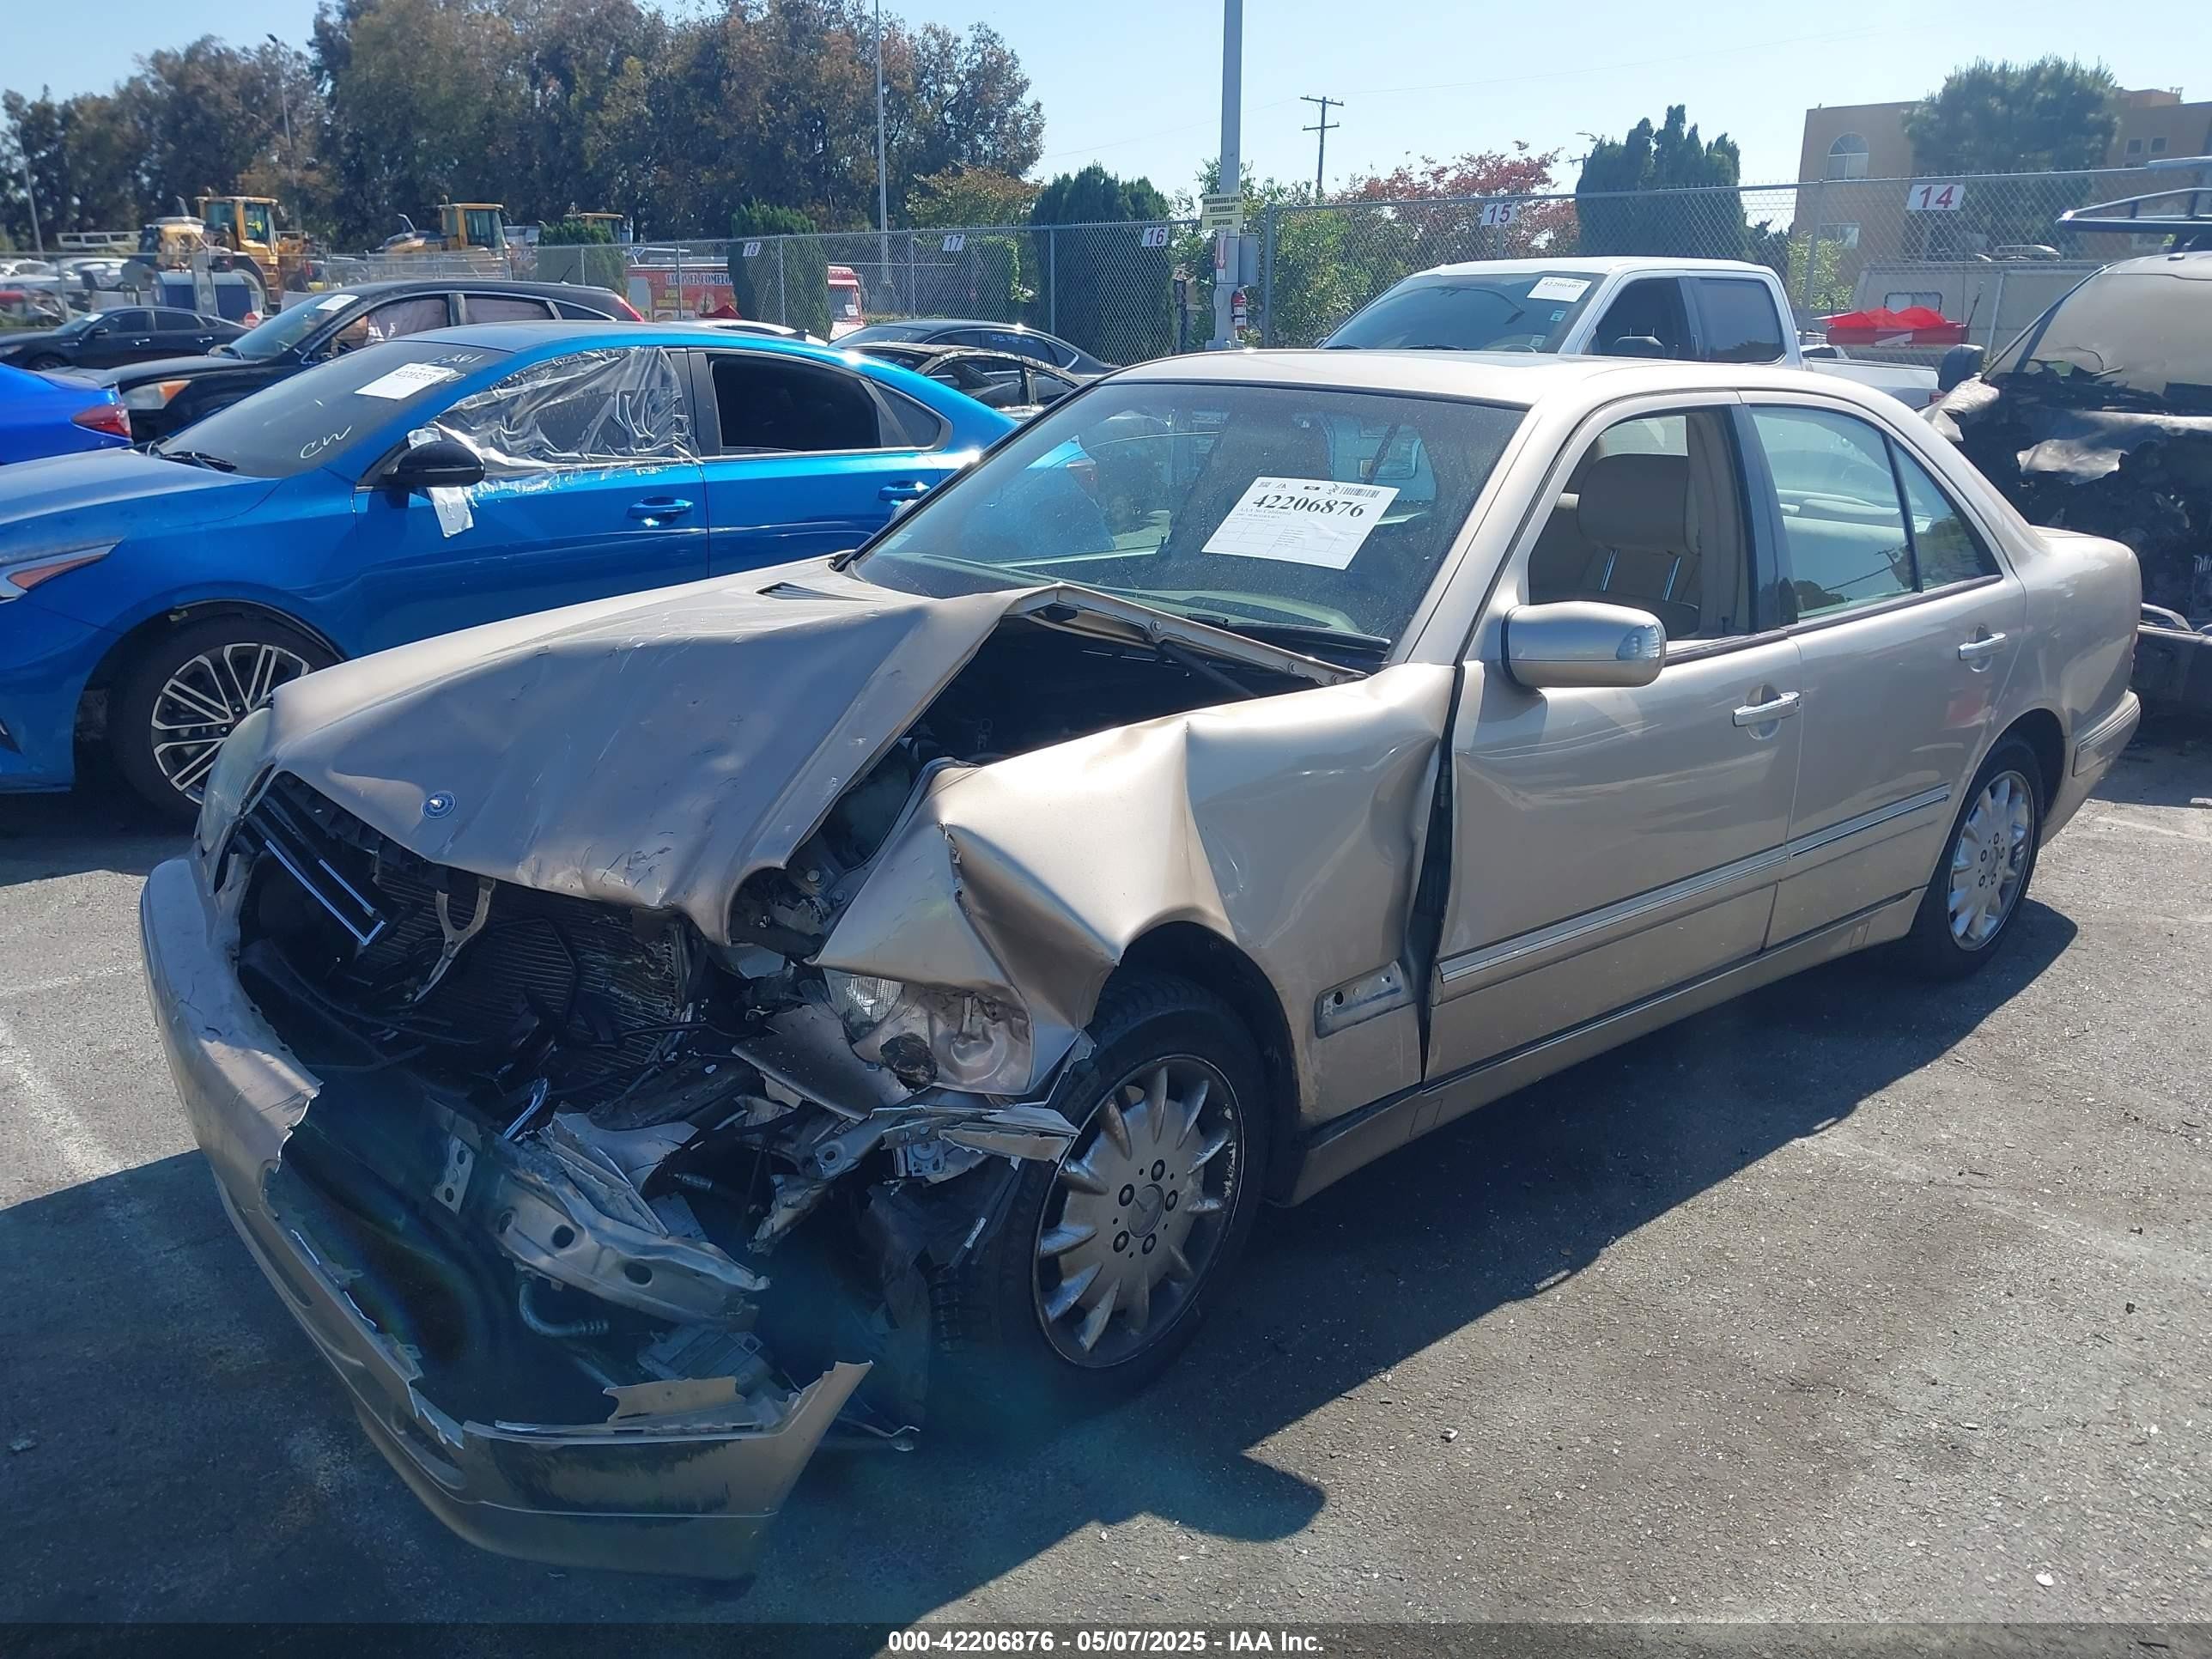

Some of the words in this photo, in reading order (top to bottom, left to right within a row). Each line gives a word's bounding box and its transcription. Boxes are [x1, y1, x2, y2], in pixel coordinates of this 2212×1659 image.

[1920, 185, 1954, 209] 14
[1490, 204, 1511, 224] 15
[948, 235, 963, 250] 17
[1148, 228, 1165, 246] 16
[1253, 494, 1367, 518] 42206876
